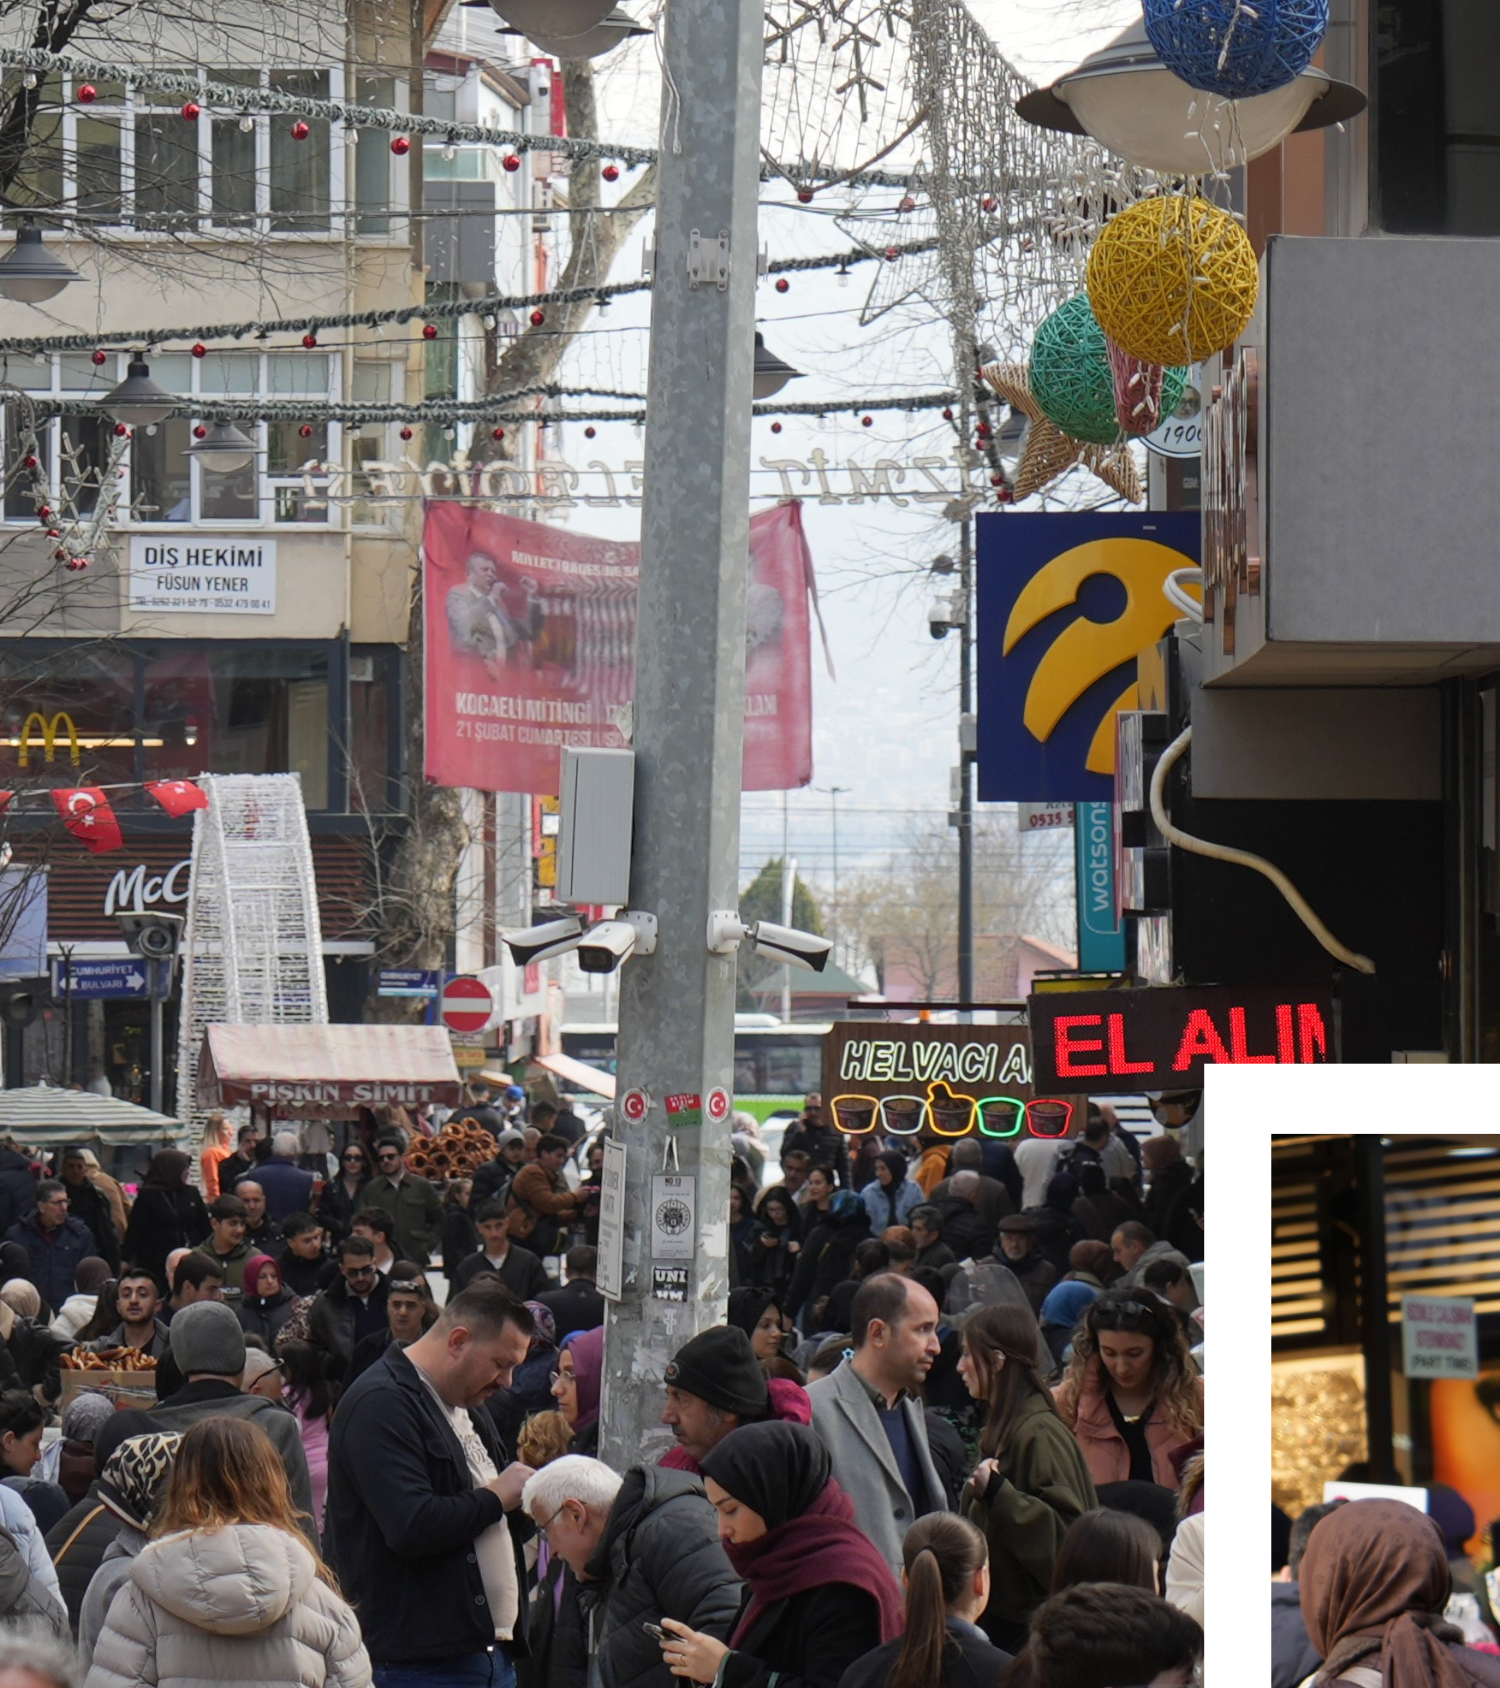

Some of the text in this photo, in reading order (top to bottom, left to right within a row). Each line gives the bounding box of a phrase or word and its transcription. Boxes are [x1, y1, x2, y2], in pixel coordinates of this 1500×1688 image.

[145, 544, 263, 569] DİŞ HEKİMİ
[157, 573, 249, 592] FÜSUN YENER
[455, 692, 522, 719] KOCAELİ
[1029, 811, 1063, 827] 0535
[104, 858, 192, 917] McC
[80, 979, 124, 990] BULVARI
[1053, 1014, 1156, 1078] EL
[839, 1040, 1032, 1084] HELVACI A
[250, 1080, 436, 1104] PİŞKİN SİMİT
